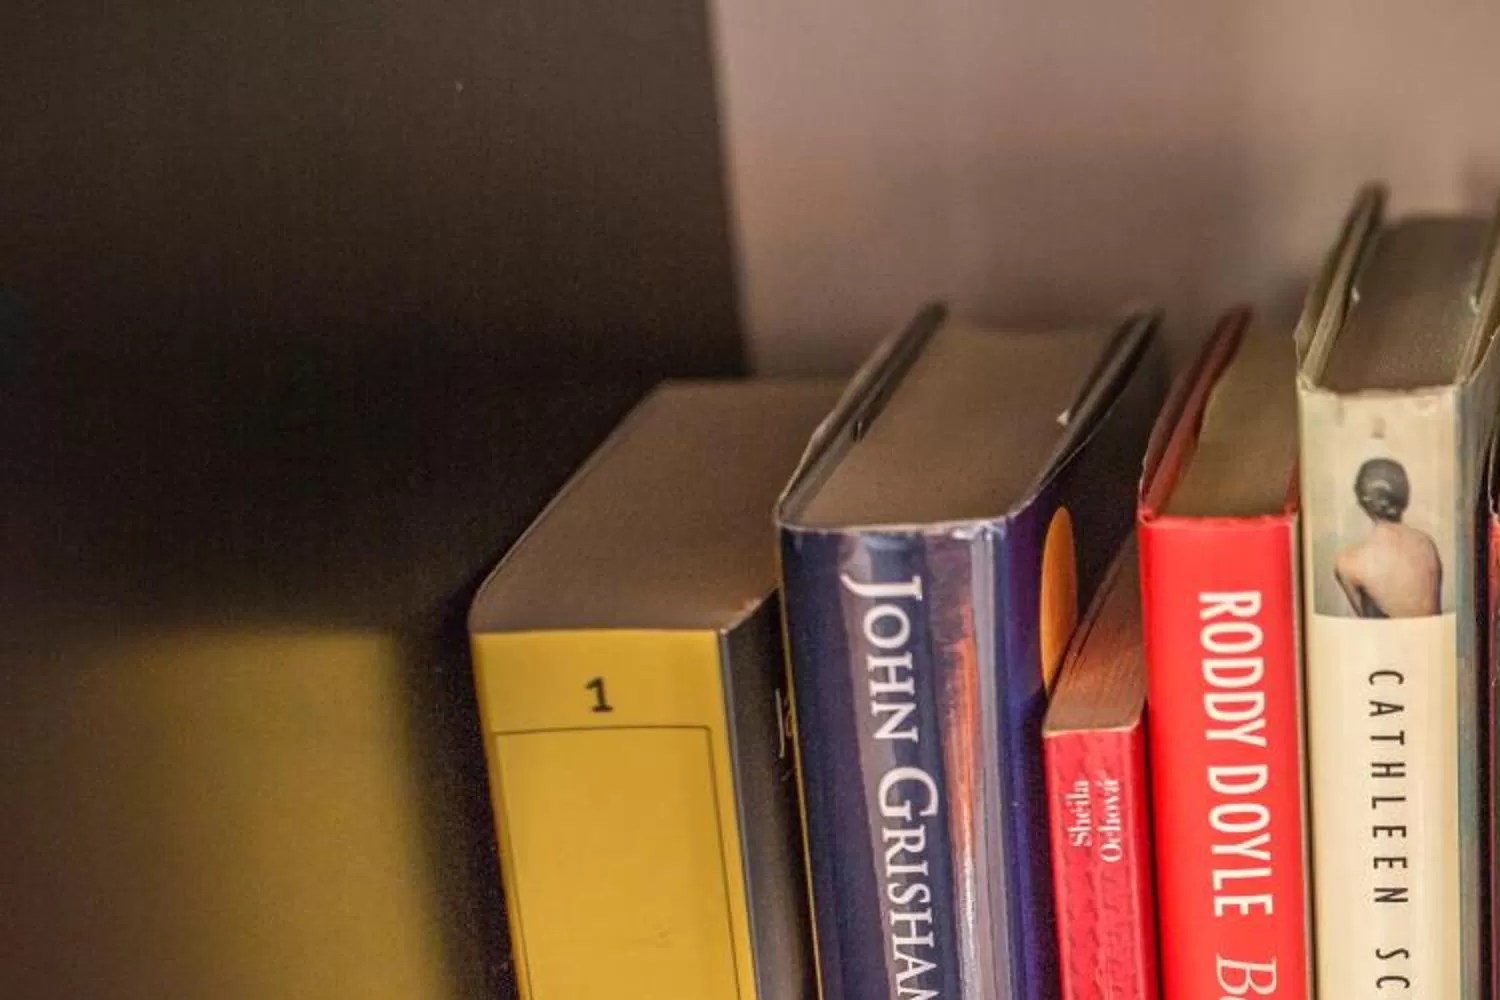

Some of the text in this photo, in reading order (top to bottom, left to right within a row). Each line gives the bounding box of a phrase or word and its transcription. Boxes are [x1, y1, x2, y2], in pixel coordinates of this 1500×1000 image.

[585, 677, 613, 712] 1
[840, 573, 923, 744] JOHN
[1198, 590, 1267, 748] RODDY
[1207, 765, 1273, 917] DOYLE
[1369, 669, 1408, 904] CATHLEEN
